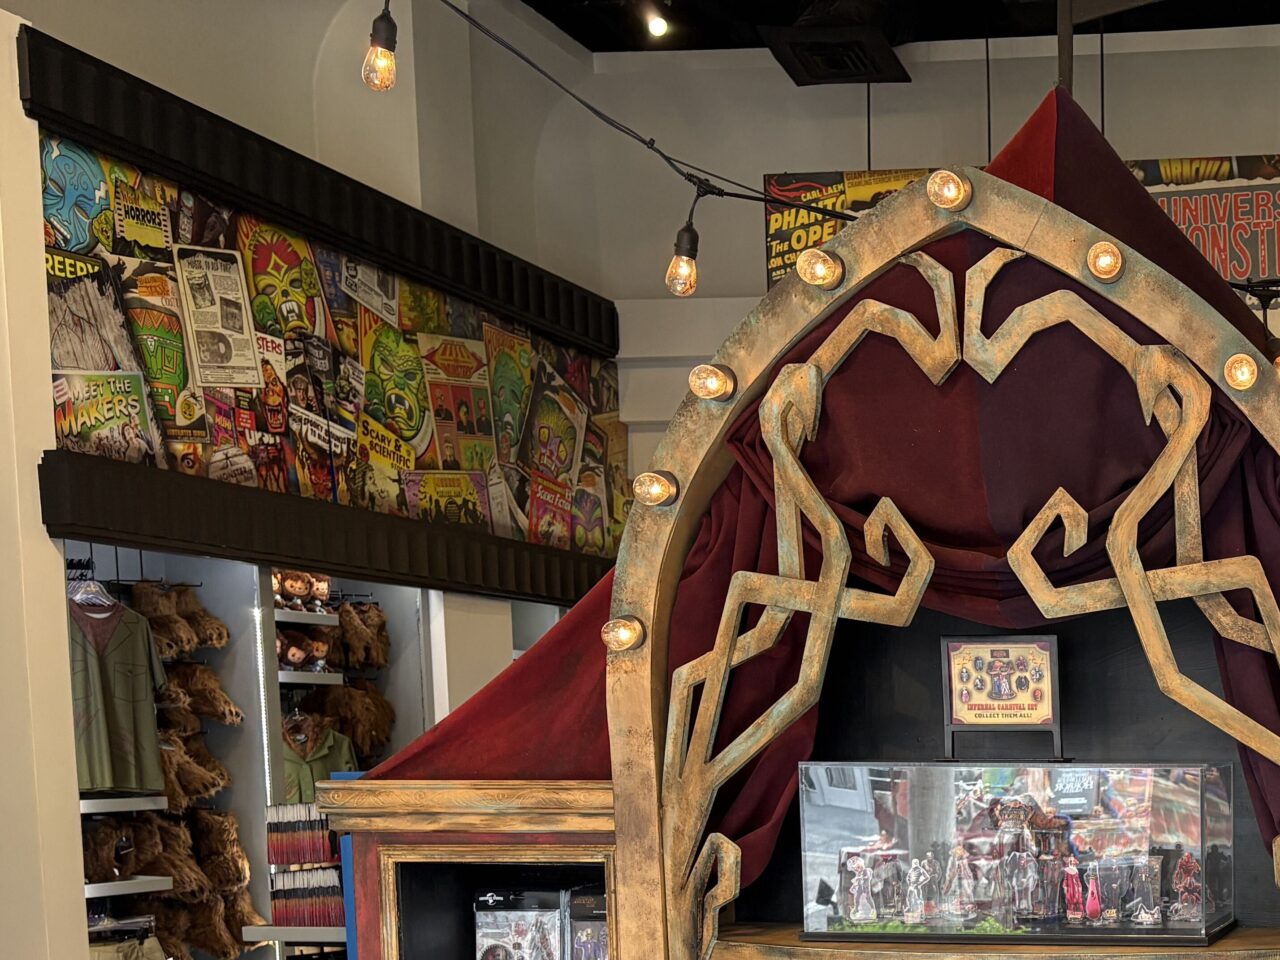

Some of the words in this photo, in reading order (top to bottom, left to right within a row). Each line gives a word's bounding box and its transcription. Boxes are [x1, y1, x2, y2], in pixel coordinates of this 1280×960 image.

[801, 189, 820, 202] CARL
[123, 203, 162, 228] HORRORS
[770, 240, 790, 257] THE
[69, 382, 105, 402] MEET
[108, 378, 132, 394] THE
[55, 395, 141, 437] MAKERS
[361, 419, 392, 447] SCARY
[394, 438, 403, 451] &
[369, 440, 411, 469] SCIENTIFIC
[967, 703, 996, 711] INFERNAL
[997, 703, 1026, 711] CARNIVAL
[1027, 703, 1038, 711] SET
